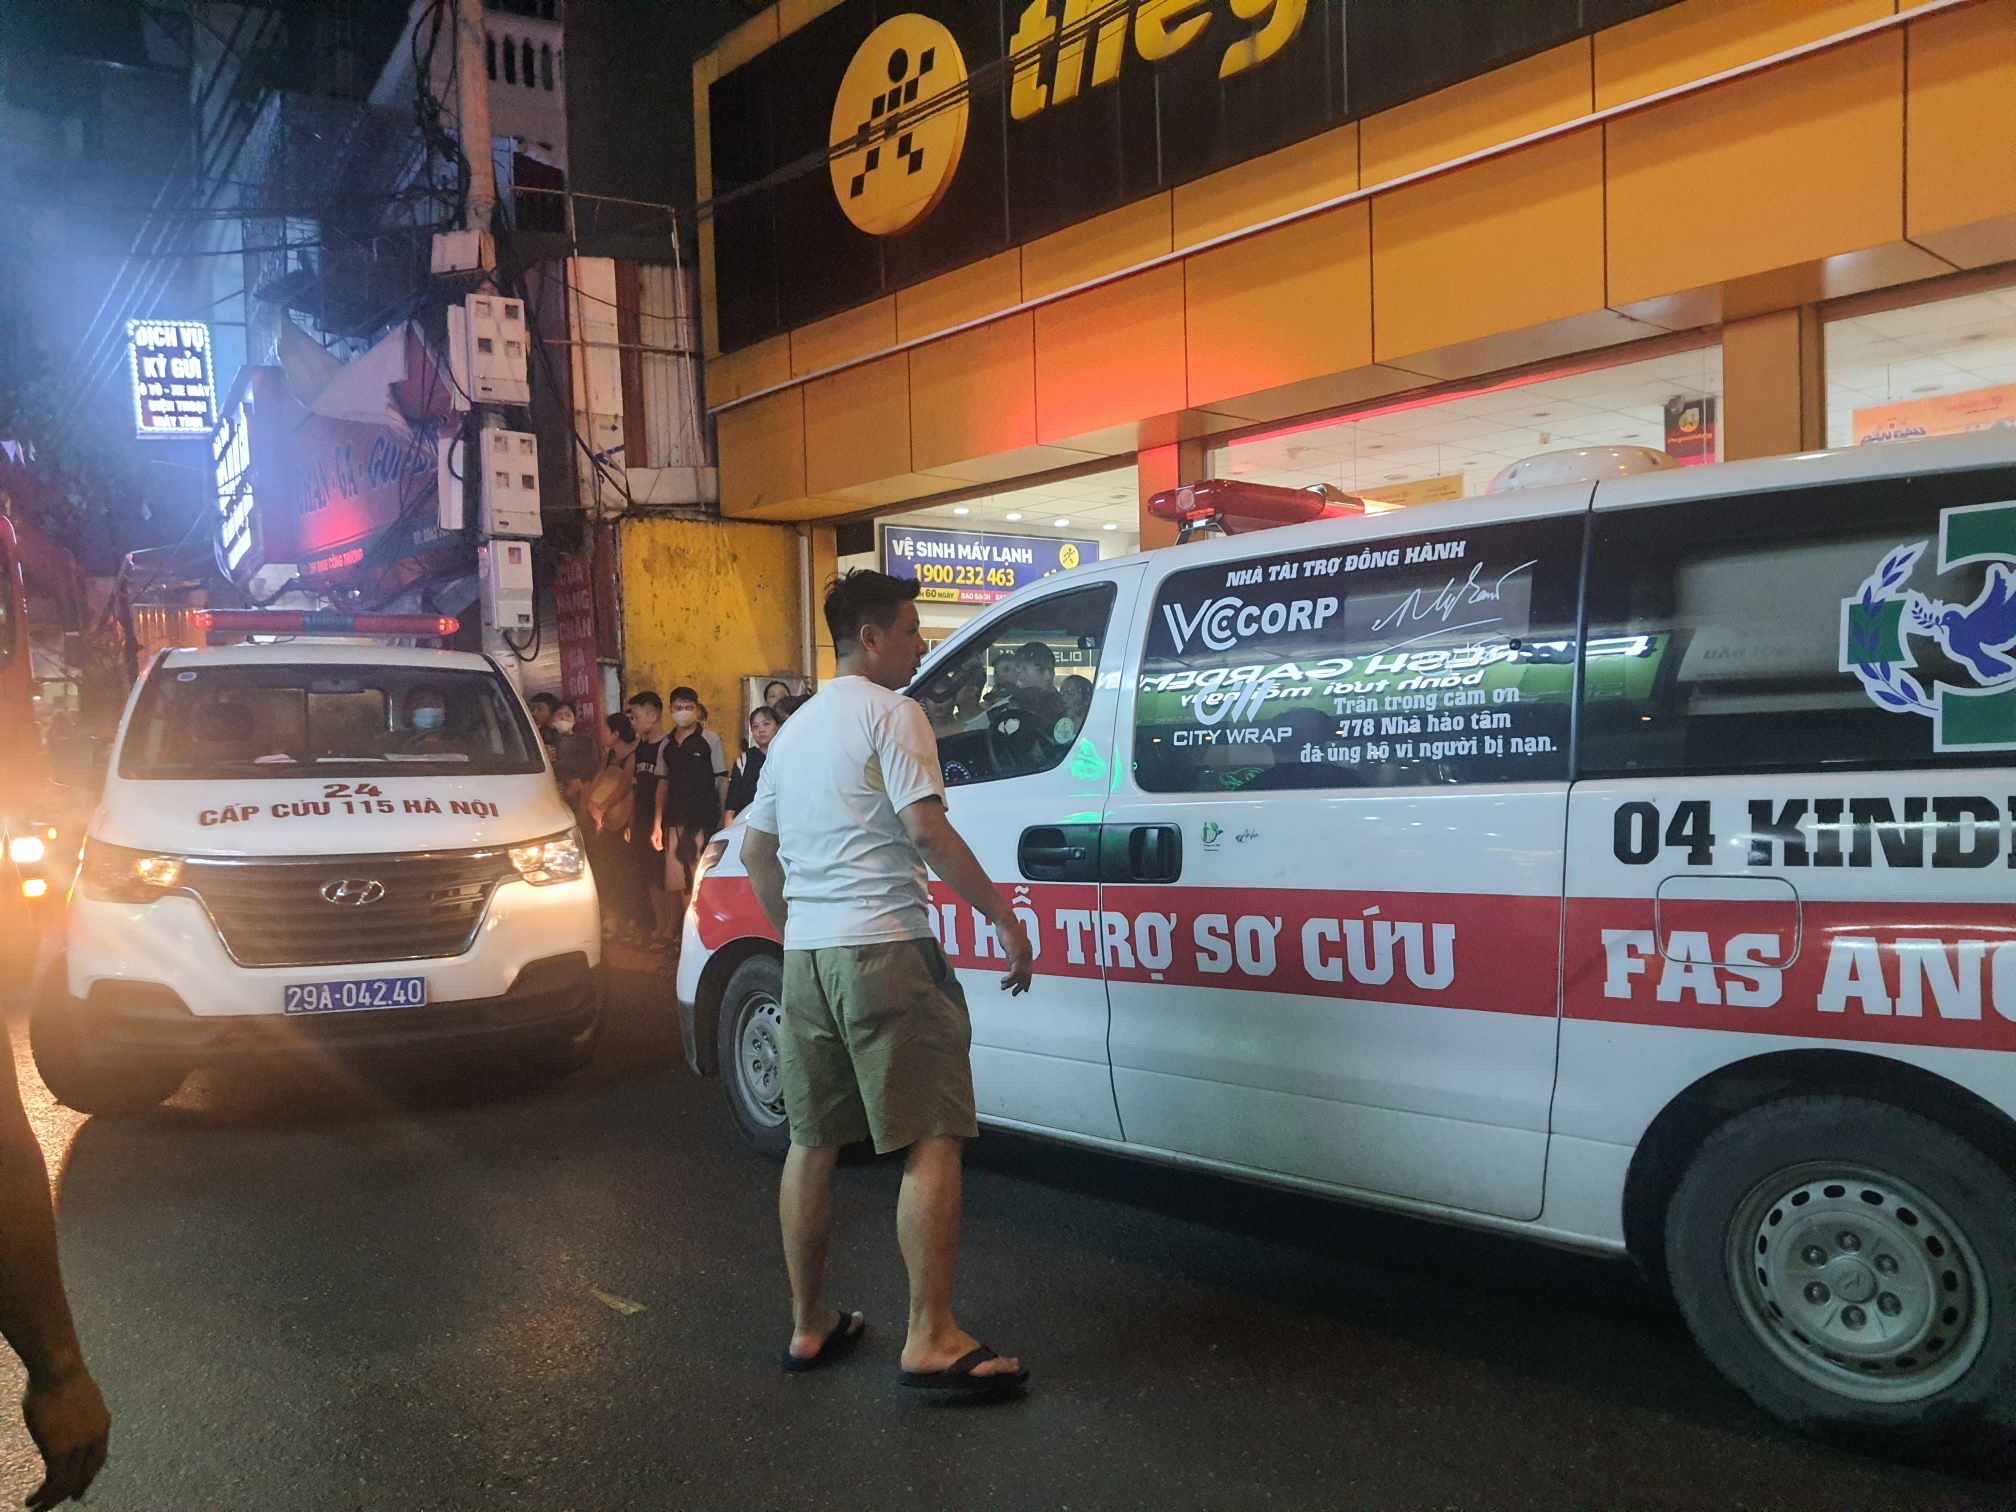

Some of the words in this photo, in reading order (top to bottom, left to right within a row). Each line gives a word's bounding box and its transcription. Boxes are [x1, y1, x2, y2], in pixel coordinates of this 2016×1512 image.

[135, 326, 178, 351] DỊCH
[180, 327, 205, 352] VỤ
[892, 537, 914, 560] VỆ
[916, 542, 956, 560] SINH
[957, 540, 990, 561] MÁY
[991, 546, 1033, 566] LẠNH
[1226, 565, 1263, 588] NHÀ
[1268, 561, 1298, 582] TÀI
[1303, 556, 1343, 578] TRỢ
[1344, 547, 1400, 572] ĐỒNG
[1404, 541, 1467, 565] HÀNH
[914, 563, 953, 583] 1900
[955, 566, 984, 586] 232
[987, 569, 1015, 587] 463
[1334, 694, 1378, 715] Trân
[1384, 690, 1438, 713] trọng
[1443, 686, 1485, 707] cảm
[1492, 687, 1520, 703] ơn
[1173, 729, 1221, 746] CITY
[1226, 727, 1292, 744] WRAP
[1340, 719, 1374, 738] 778
[1381, 716, 1420, 736] Nhà
[1426, 711, 1464, 732] hảo
[1471, 711, 1511, 730] tâm
[1300, 742, 1322, 763] đã
[1327, 741, 1361, 763] ủng
[1367, 741, 1390, 764] hộ
[1396, 739, 1413, 759] vì
[1419, 737, 1477, 760] người
[1485, 735, 1504, 757] bị
[1510, 735, 1557, 758] nạn.
[323, 783, 382, 798] 24
[199, 802, 259, 827] CẤP
[342, 799, 394, 815] 115
[404, 797, 441, 814] HÀ
[450, 799, 499, 819] NỘI
[1613, 800, 1715, 865] 04
[1748, 795, 2016, 869] KIND
[1056, 908, 1177, 980] TRỢ
[1193, 912, 1282, 977] SƠ
[1301, 904, 1455, 990] CỨU
[1600, 928, 1784, 1008] FAS
[287, 978, 423, 1011] 29A-042.40
